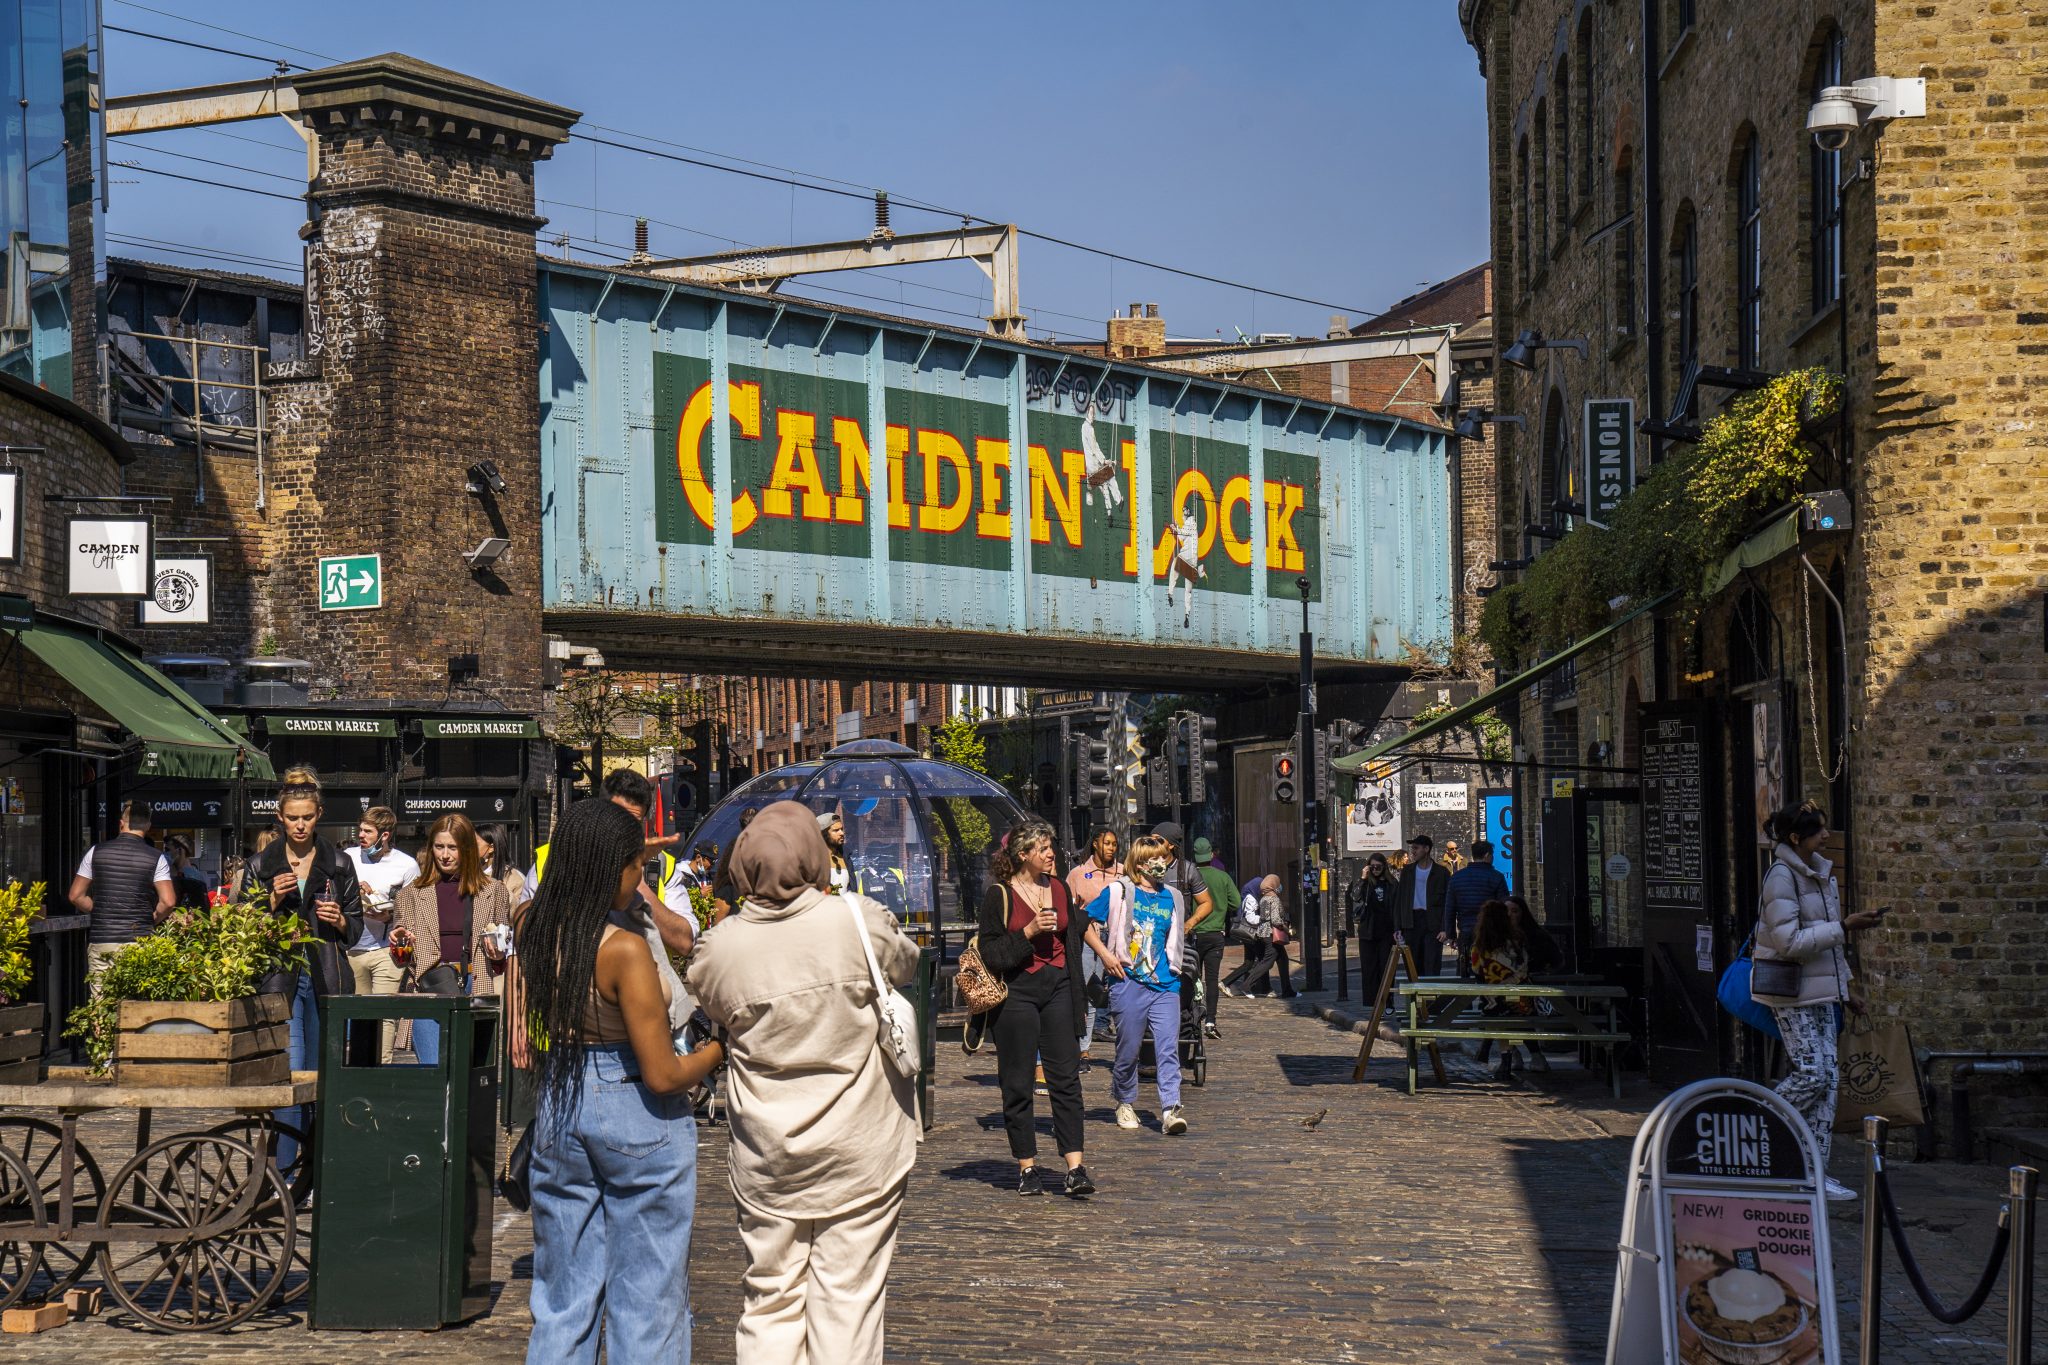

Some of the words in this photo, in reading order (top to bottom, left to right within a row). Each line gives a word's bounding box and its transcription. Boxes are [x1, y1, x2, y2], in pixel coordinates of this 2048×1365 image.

[1054, 371, 1136, 422] FOOT
[676, 379, 1091, 548] CAMDEN
[1121, 438, 1306, 577] LOCK
[79, 543, 139, 554] CAMDEN
[92, 548, 124, 570] Coffee
[154, 568, 174, 583] RVEST
[175, 568, 200, 589] GARDEN
[286, 719, 332, 732] CAMDEN
[336, 720, 380, 733] MARKET
[438, 722, 482, 734] CAMDEN
[484, 723, 524, 734] MARKET
[1417, 791, 1442, 799] CHALK
[1444, 791, 1466, 799] FARM
[154, 800, 192, 812] CAMDEN
[252, 800, 280, 810] CAMDE
[405, 799, 440, 809] CHURROS
[441, 799, 467, 809] DONUT
[1840, 1051, 1888, 1073] ROKIT
[1847, 1086, 1887, 1103] LONDON
[1696, 1112, 1758, 1140] CHIN
[1759, 1115, 1772, 1167] LABS
[1697, 1139, 1759, 1167] CHIN
[1699, 1166, 1723, 1174] NITRO
[1727, 1167, 1771, 1176] ICE-CREAM
[1682, 1203, 1724, 1219] NEW!
[1743, 1208, 1810, 1225] GRIDDLED
[1758, 1226, 1811, 1241] COOKIE
[1759, 1241, 1811, 1257] DOUGH
